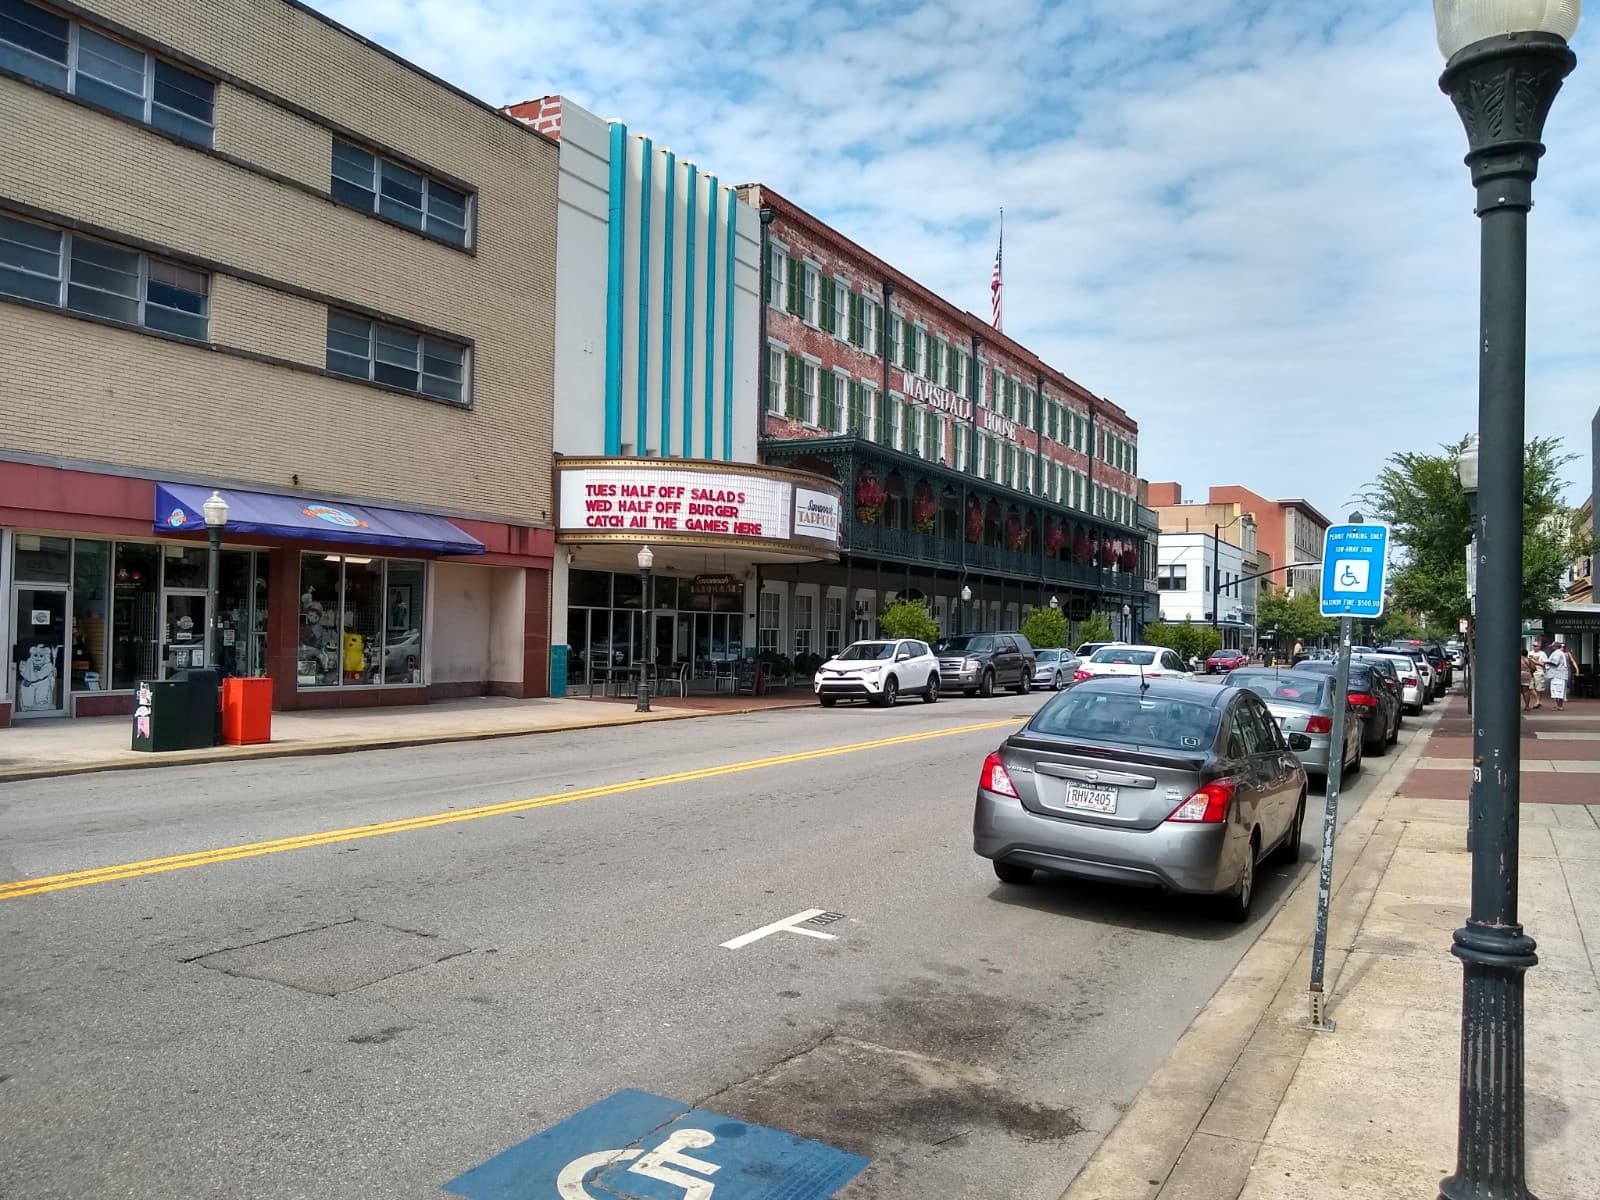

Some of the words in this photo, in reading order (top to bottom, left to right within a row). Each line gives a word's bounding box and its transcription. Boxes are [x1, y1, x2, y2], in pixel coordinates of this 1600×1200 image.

[903, 371, 973, 422] MARSHALL
[984, 409, 1017, 441] HOUSE
[586, 484, 616, 497] TUES
[621, 484, 656, 497] HALF
[659, 486, 685, 498] OFF
[691, 488, 746, 504] SALADS
[586, 499, 613, 512] WED
[618, 500, 654, 512] HALF
[655, 501, 682, 514] OFF
[689, 503, 739, 519] BURGER
[586, 515, 624, 527] CATCH
[653, 516, 677, 529] THE
[685, 518, 729, 532] GAMES
[733, 521, 762, 535] HERE
[1346, 532, 1368, 540] PARKING
[1072, 789, 1111, 806] RHV2405
